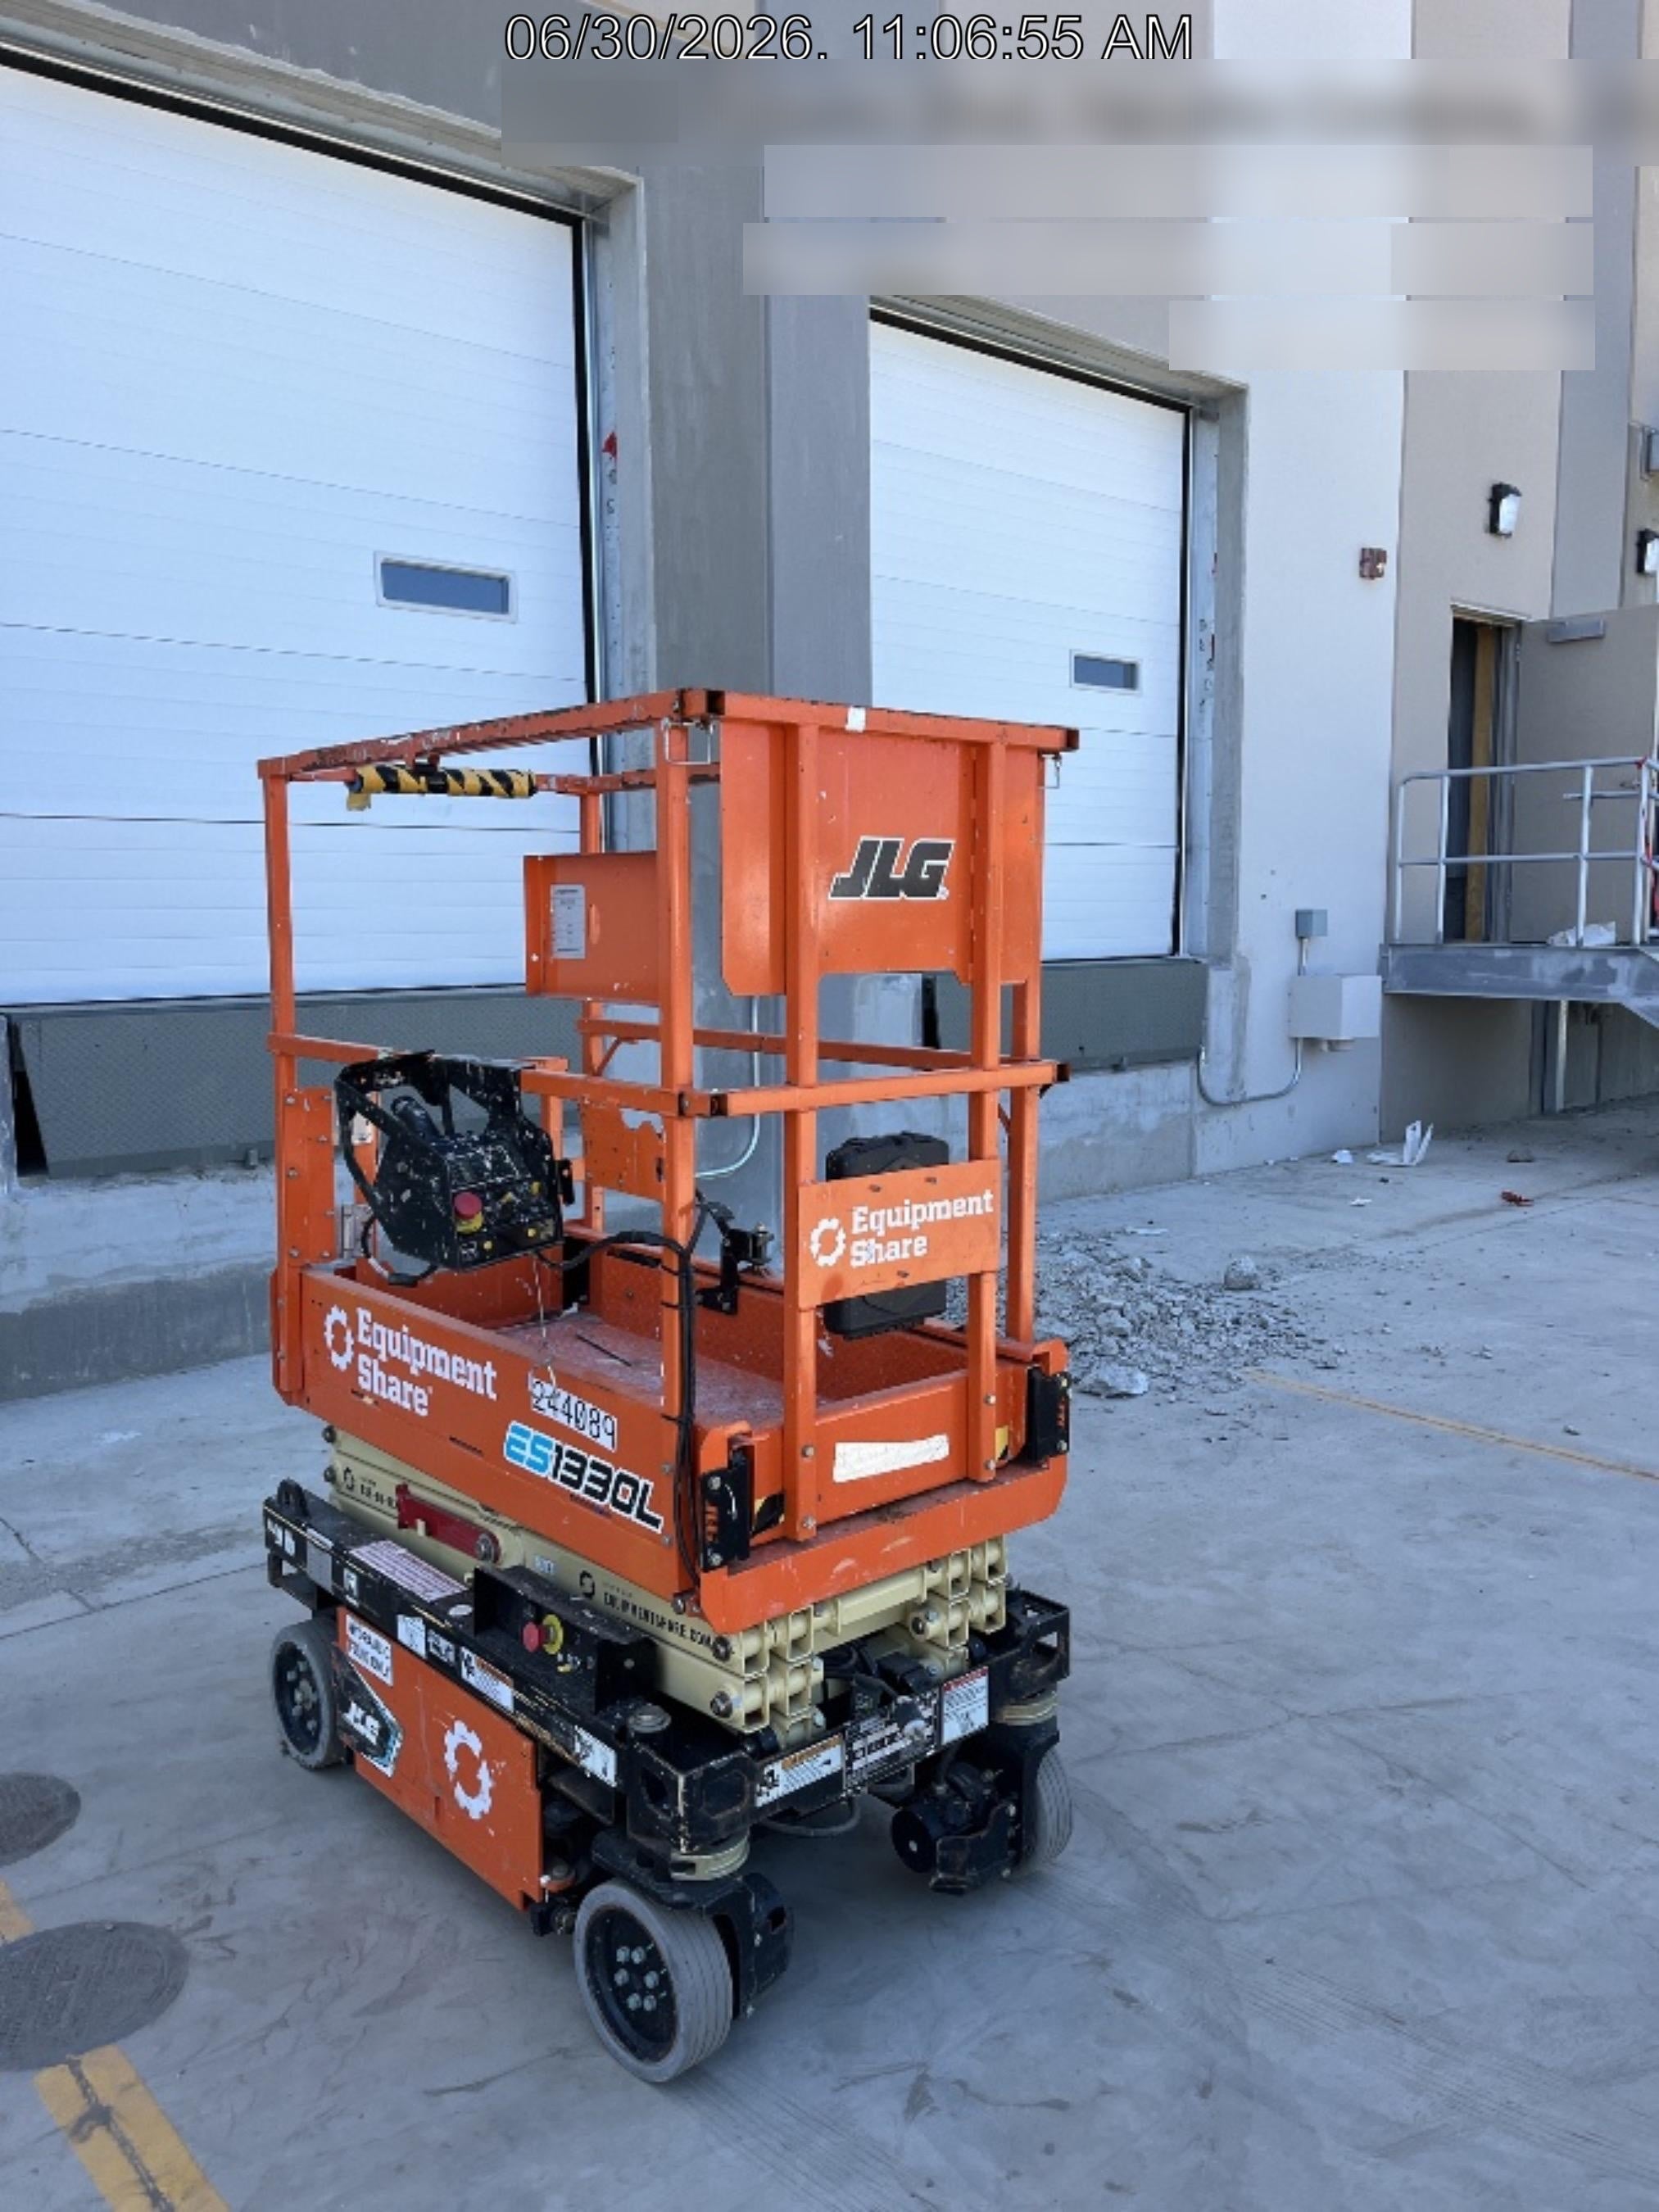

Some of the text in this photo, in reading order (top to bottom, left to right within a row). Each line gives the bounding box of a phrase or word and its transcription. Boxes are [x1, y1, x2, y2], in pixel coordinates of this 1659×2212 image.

[827, 836, 956, 900] JLG
[851, 1189, 994, 1236] Equipment
[850, 1235, 927, 1267] Share
[356, 1307, 497, 1401] Equipment
[357, 1353, 428, 1416] Share
[533, 1380, 615, 1450] 244089
[504, 1421, 663, 1533] ES1330L
